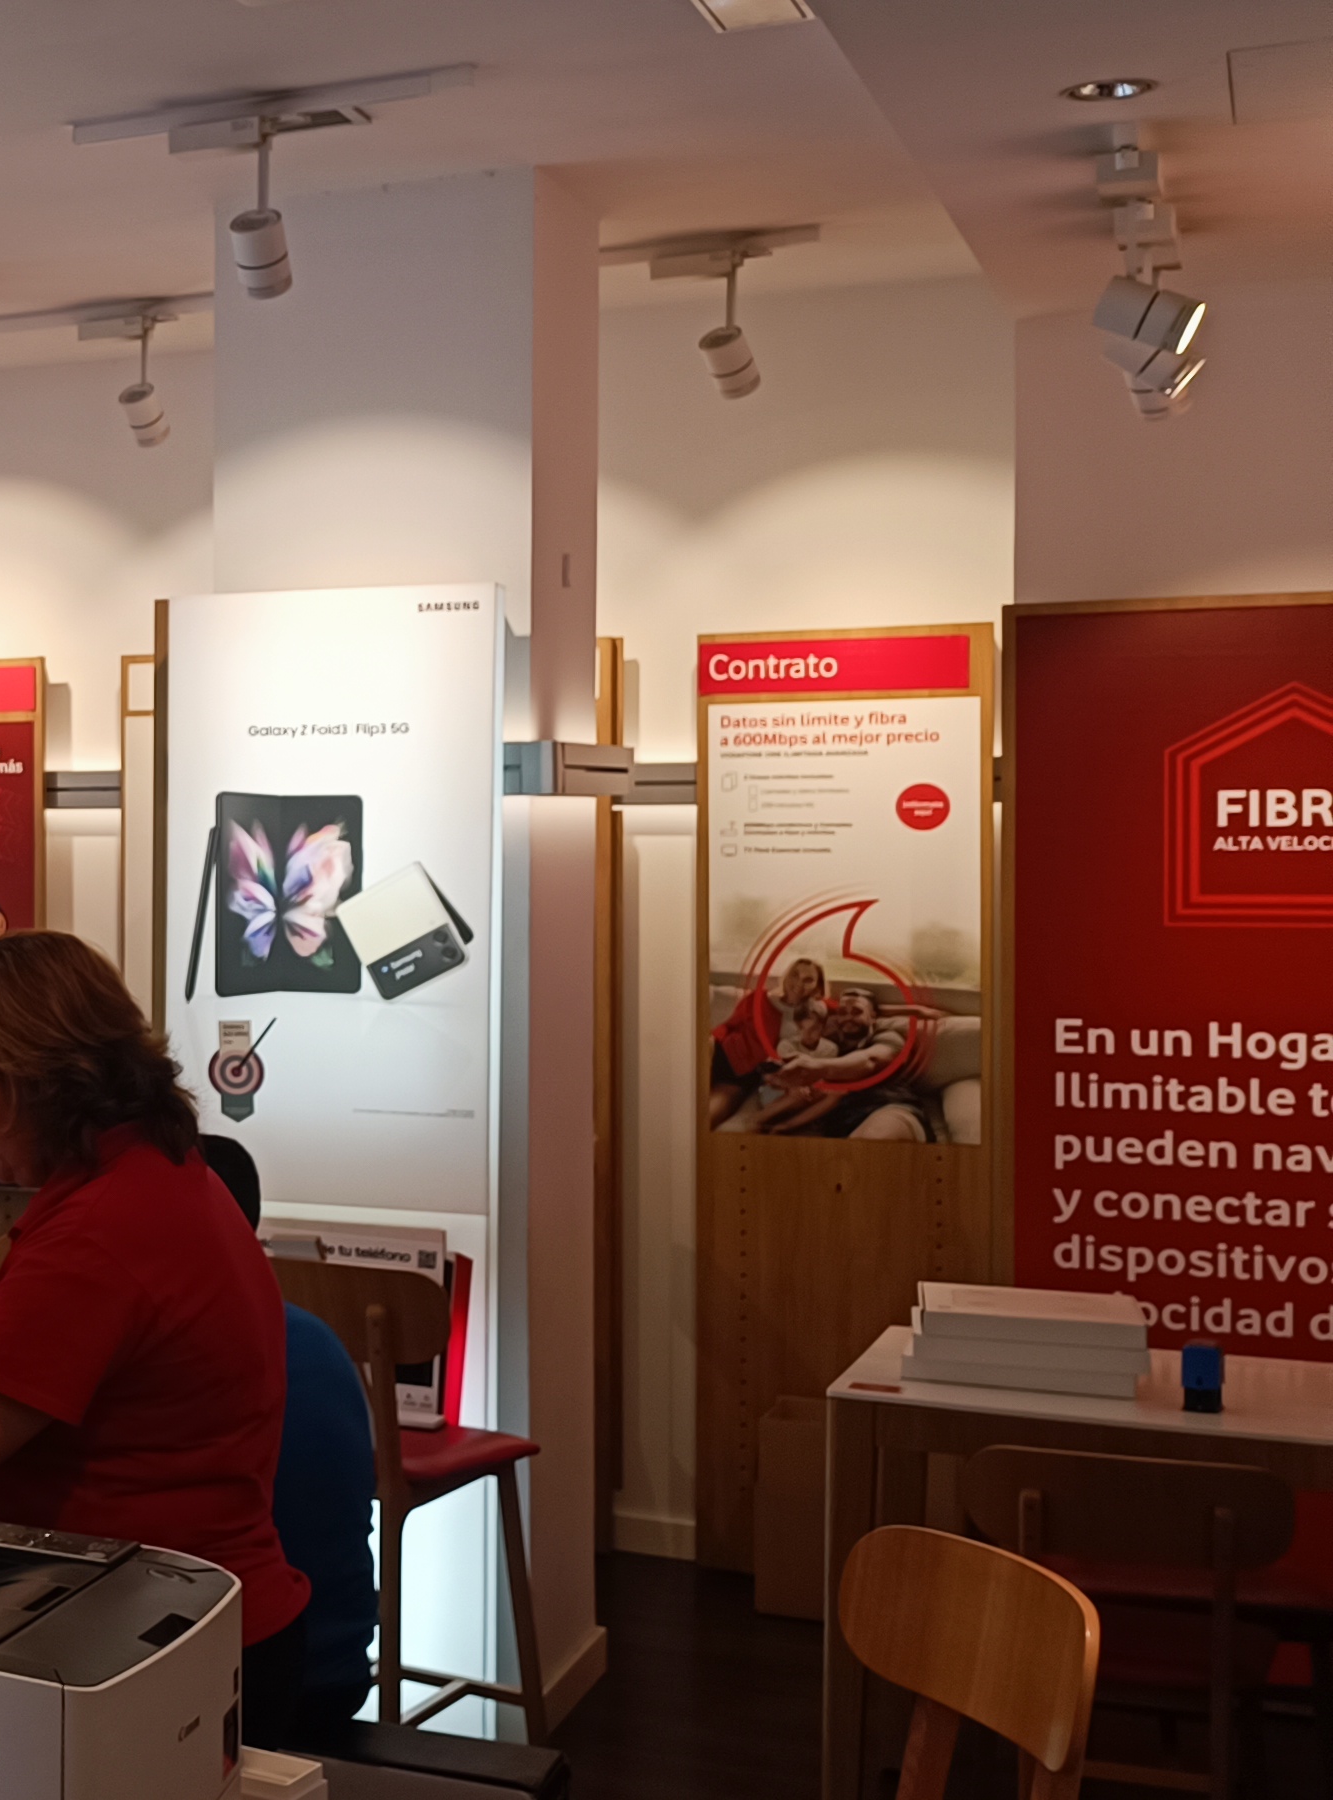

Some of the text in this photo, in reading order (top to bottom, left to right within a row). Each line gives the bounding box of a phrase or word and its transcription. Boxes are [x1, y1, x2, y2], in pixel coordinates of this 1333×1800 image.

[417, 601, 480, 612] SAMSUNG
[708, 653, 838, 681] Contrato
[248, 722, 410, 738] Galaxy Z Fold3 Flip3 5G
[720, 711, 907, 729] Datos sin límite y fibra
[720, 729, 940, 748] a 600Mbps al mejor precio
[1216, 788, 1333, 828] FIBR
[1212, 835, 1333, 851] ALTA VELOC
[1054, 1018, 1333, 1071] En un Hoga
[1054, 1071, 1296, 1117] Ilimitable
[1054, 1129, 1333, 1173] pueden nav
[1052, 1187, 1316, 1228] y conectar
[338, 1245, 352, 1256] tu
[355, 1246, 412, 1263] teléfono
[1052, 1233, 1333, 1285] dispositivo
[1136, 1295, 1294, 1338] ocidad
